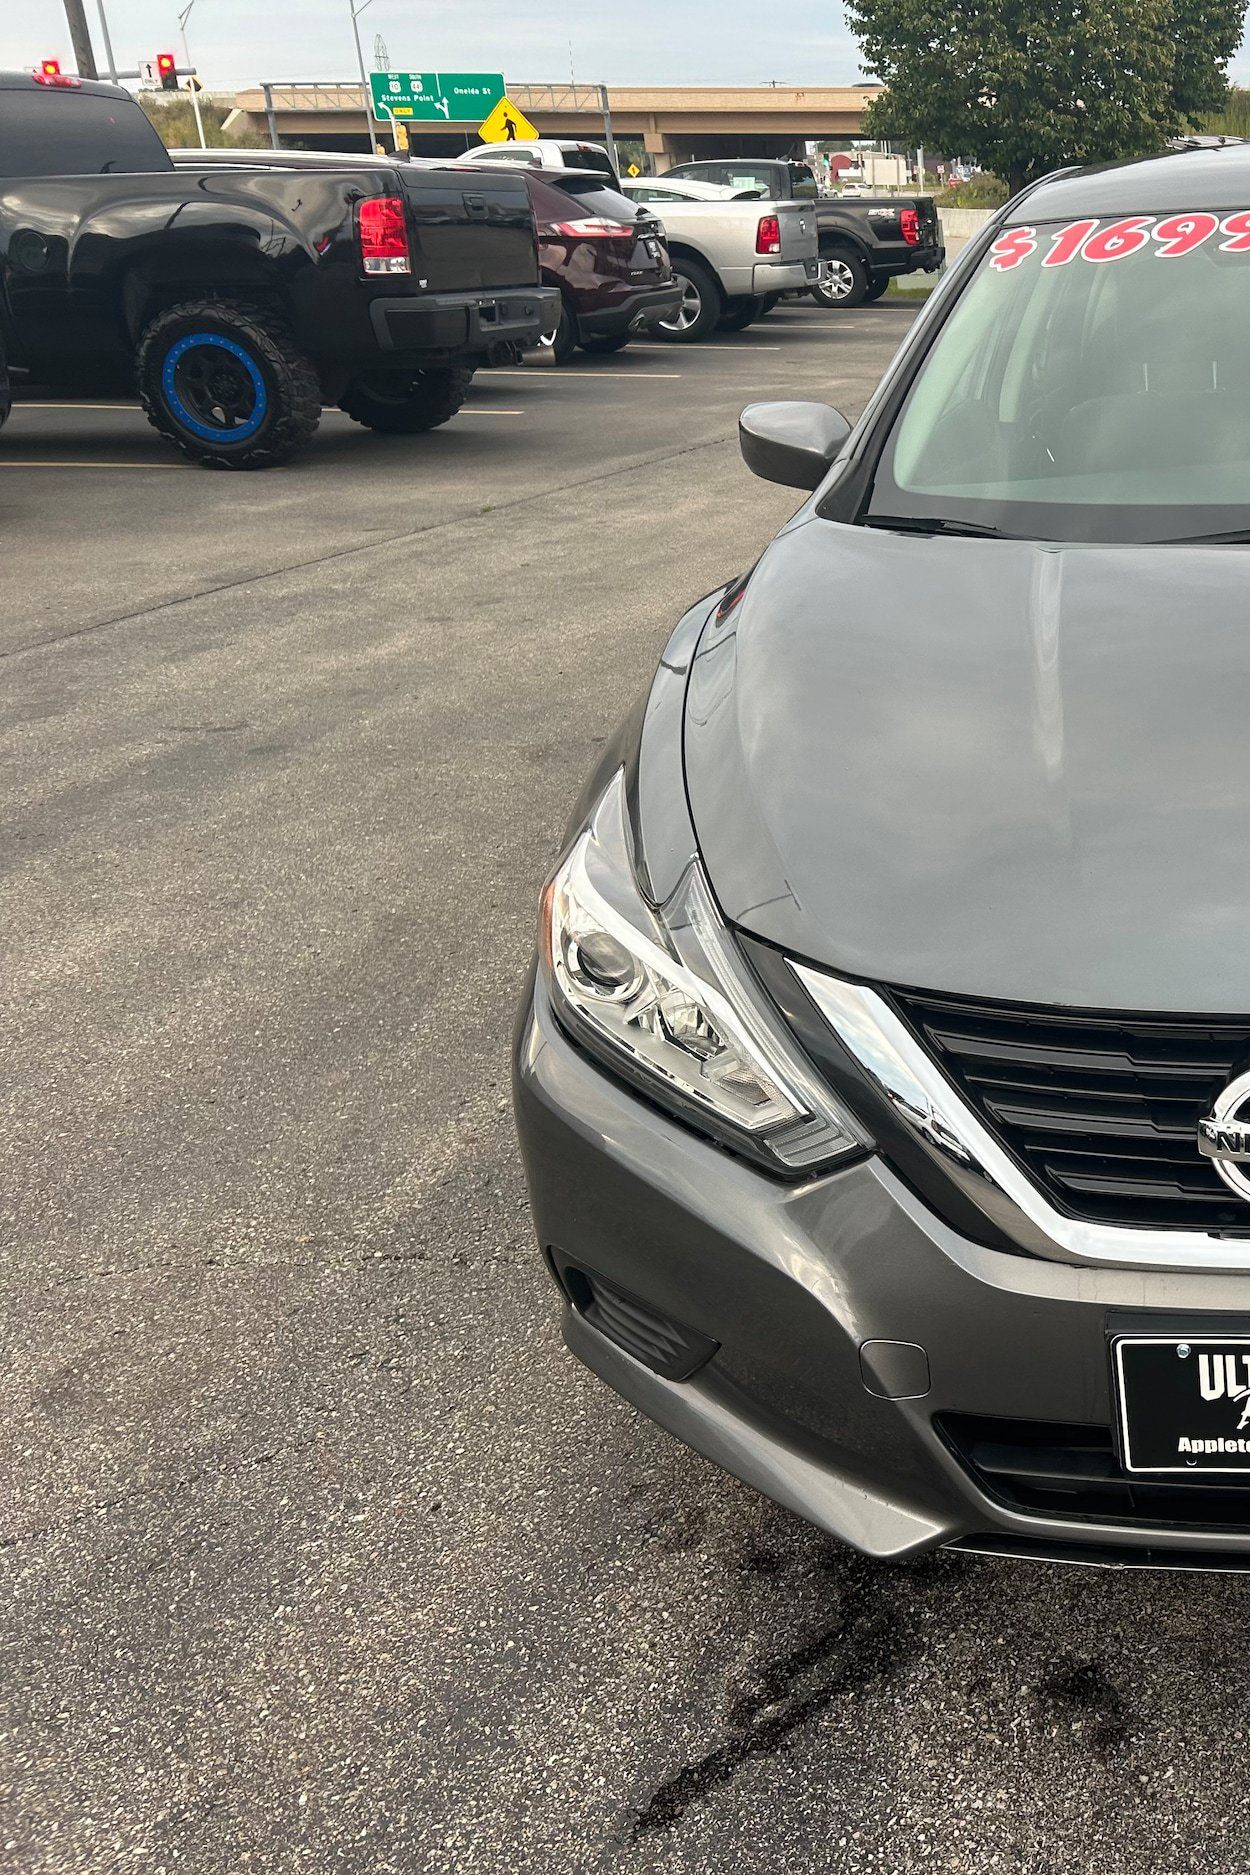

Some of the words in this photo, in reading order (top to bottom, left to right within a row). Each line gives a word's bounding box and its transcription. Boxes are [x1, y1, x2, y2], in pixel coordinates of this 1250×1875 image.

[453, 87, 480, 95] Oneida
[482, 87, 491, 95] St
[413, 94, 434, 102] Point
